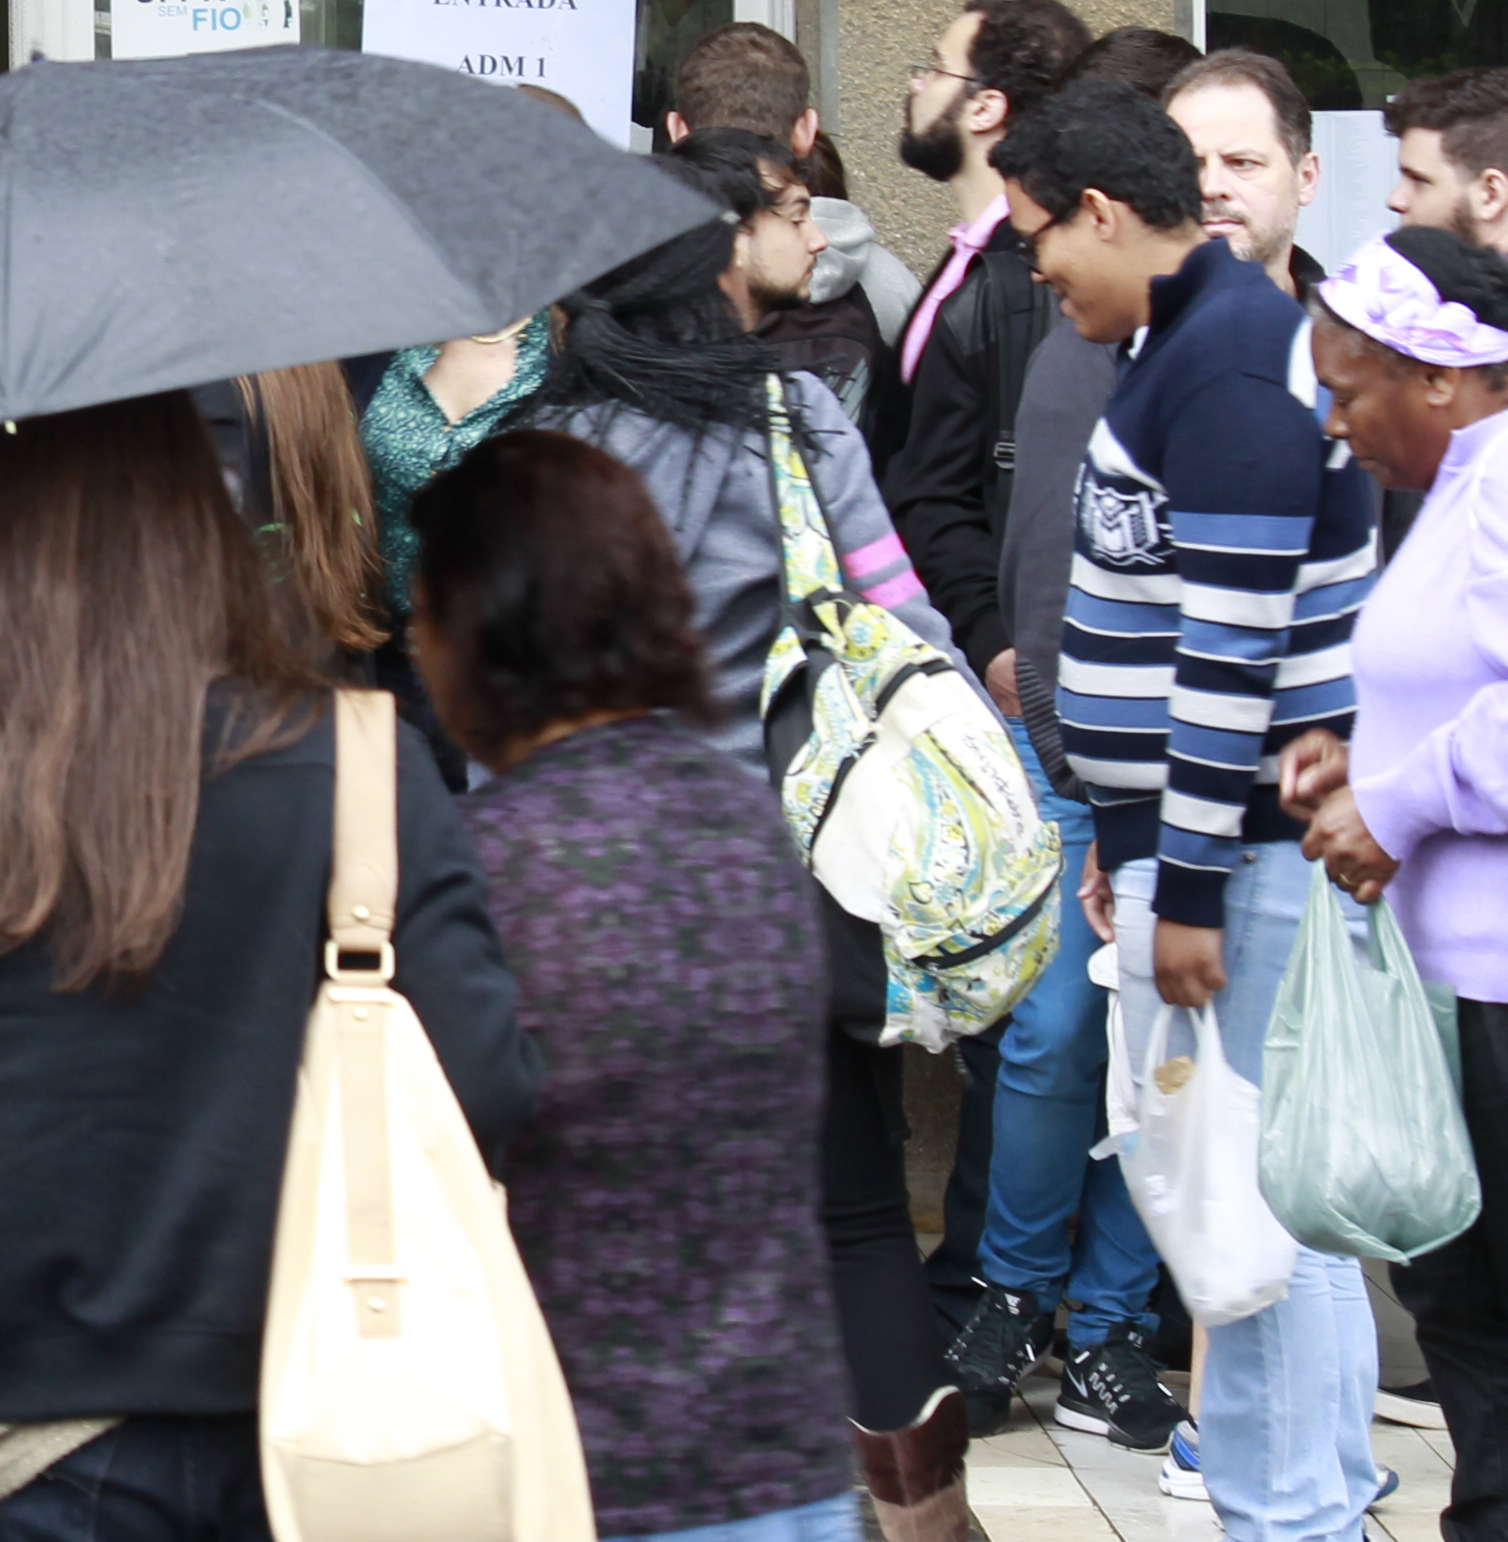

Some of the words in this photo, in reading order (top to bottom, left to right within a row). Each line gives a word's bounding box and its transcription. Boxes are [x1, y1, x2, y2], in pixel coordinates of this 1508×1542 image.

[157, 5, 188, 17] SEM
[192, 7, 242, 31] FIO
[458, 55, 525, 77] ADM
[536, 57, 548, 78] 1
